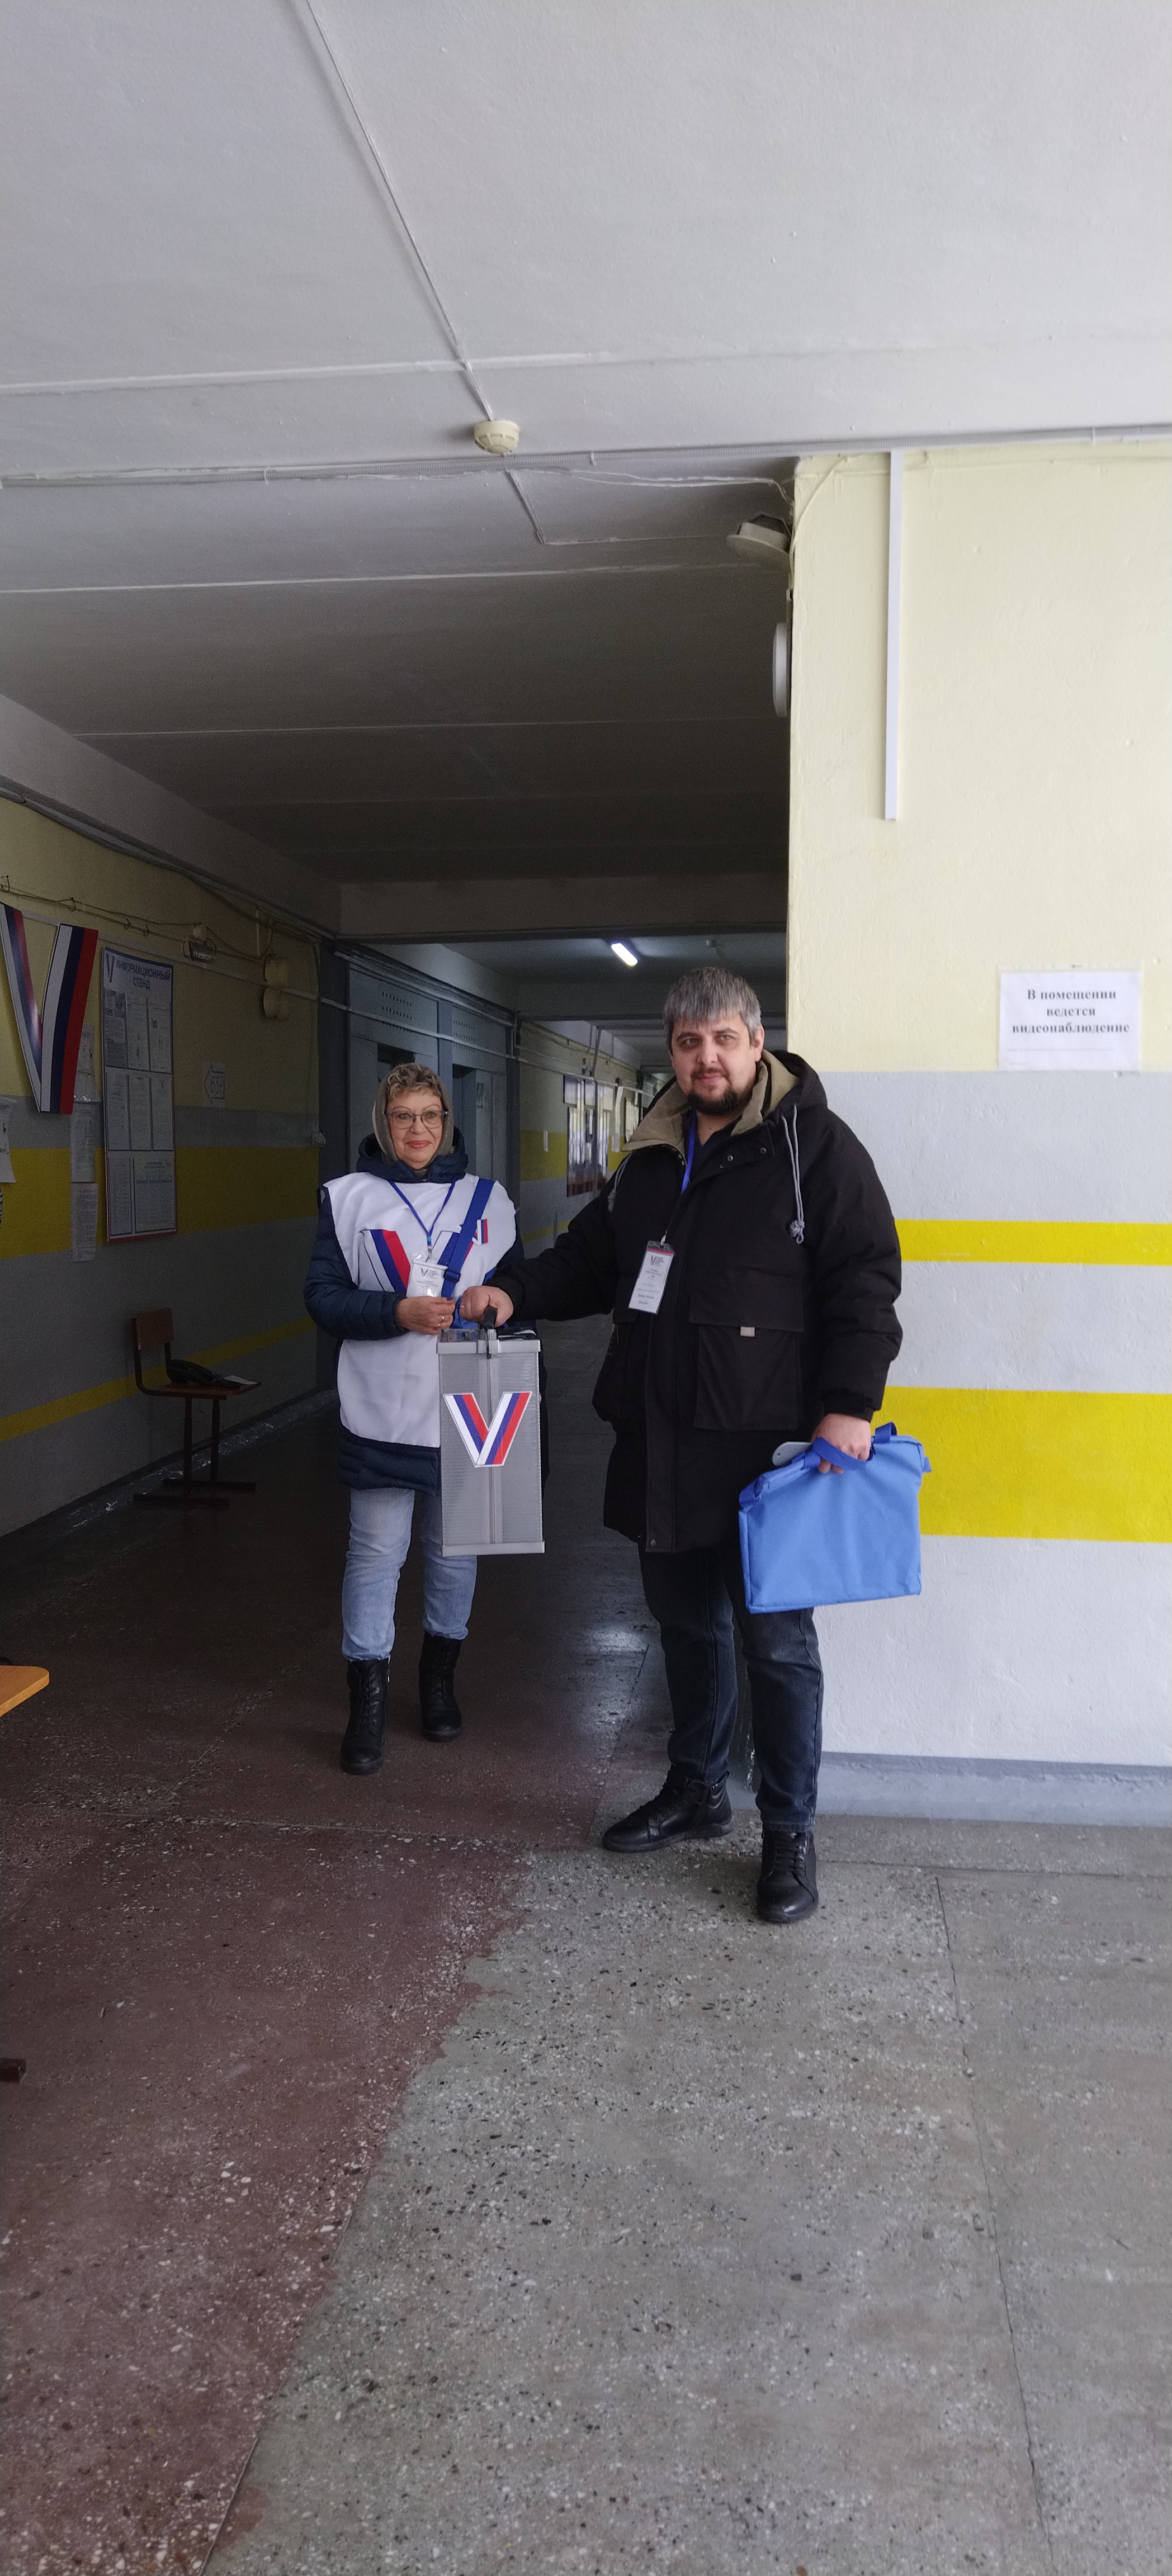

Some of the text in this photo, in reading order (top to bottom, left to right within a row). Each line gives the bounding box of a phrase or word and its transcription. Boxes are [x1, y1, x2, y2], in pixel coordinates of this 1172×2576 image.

[116, 959, 171, 981] ИНФОРМАЦИОННЫЙ
[133, 977, 151, 992] СТЕНД
[1027, 989, 1117, 1001] В помещении
[1046, 1008, 1096, 1018] ведется
[1012, 1022, 1130, 1034] видеонаблюдение
